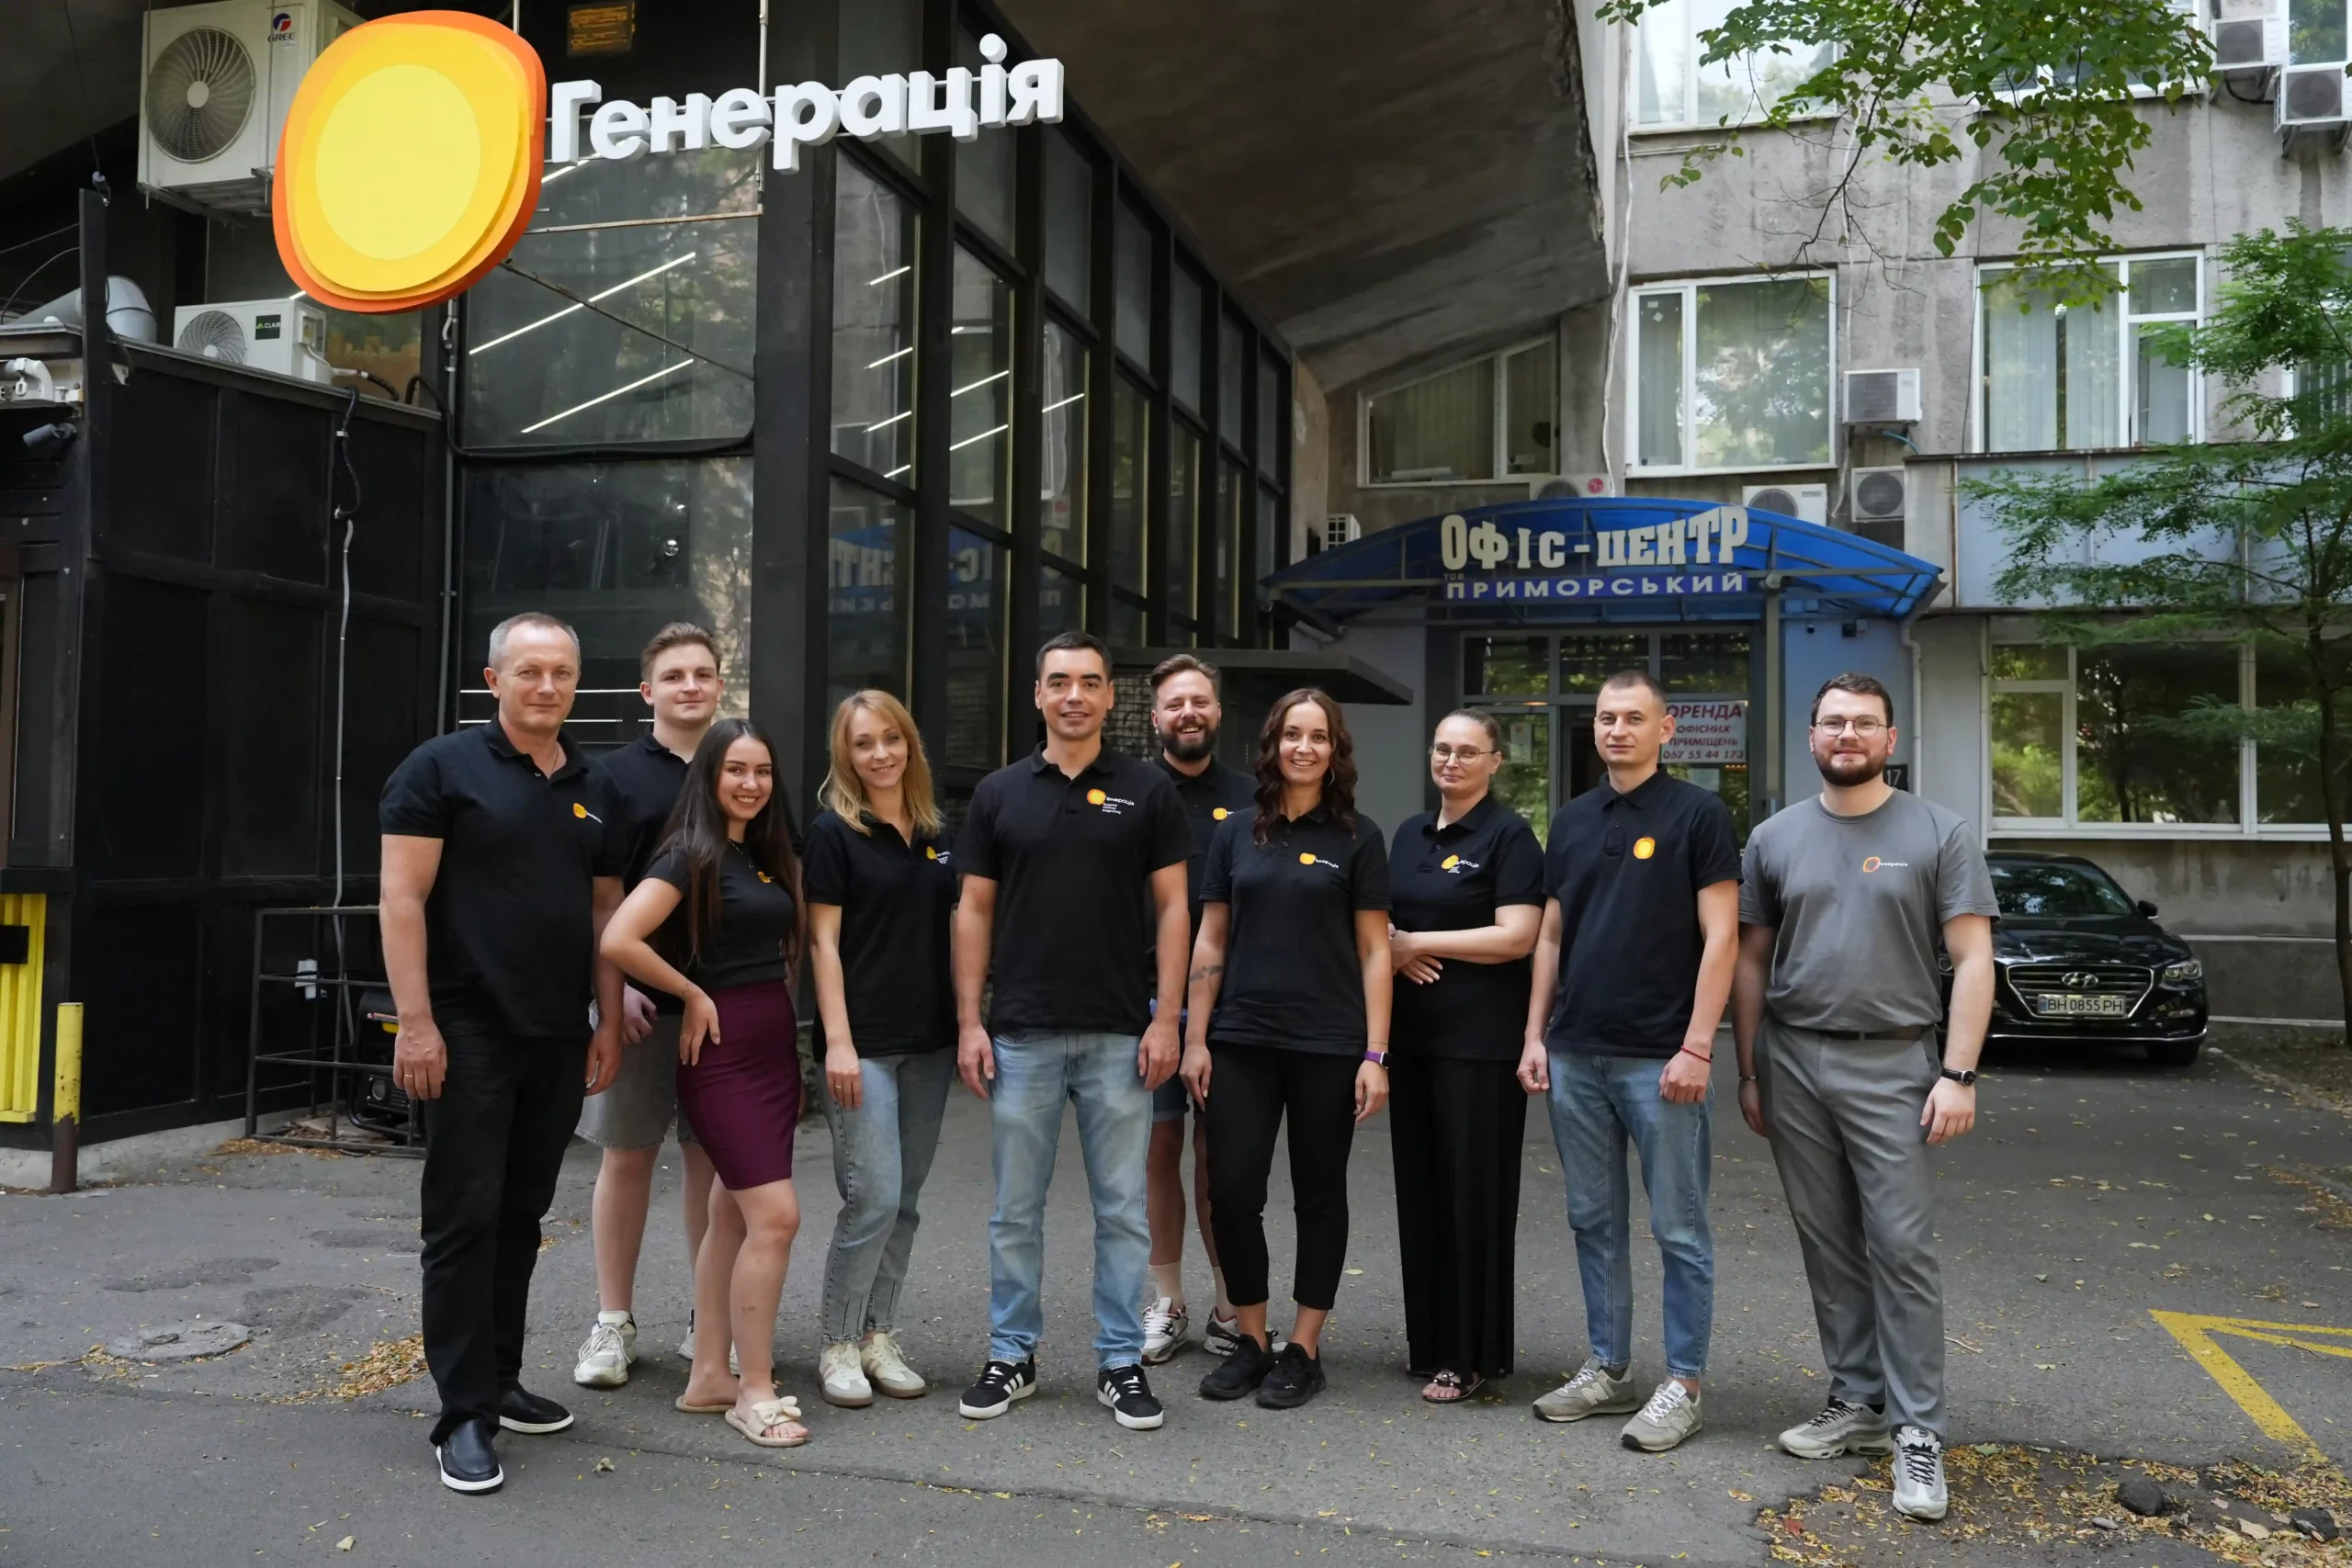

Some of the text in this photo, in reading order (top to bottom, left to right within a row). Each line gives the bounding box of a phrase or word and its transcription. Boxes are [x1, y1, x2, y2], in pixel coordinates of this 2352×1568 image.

[551, 33, 1065, 175] Генерація
[1441, 506, 1749, 570] ОФІС-ЦЕНТР
[1446, 571, 1744, 599] ПРИМОРСЬКИЙ
[1666, 705, 1742, 720] ОРЕНДА
[1676, 725, 1731, 733] ОФІСНИХ
[1668, 738, 1738, 747] ПРИМІЩЕНЬ
[1663, 750, 1744, 759] 067 55 44 173
[2048, 998, 2122, 1011] BH 0855 PH
